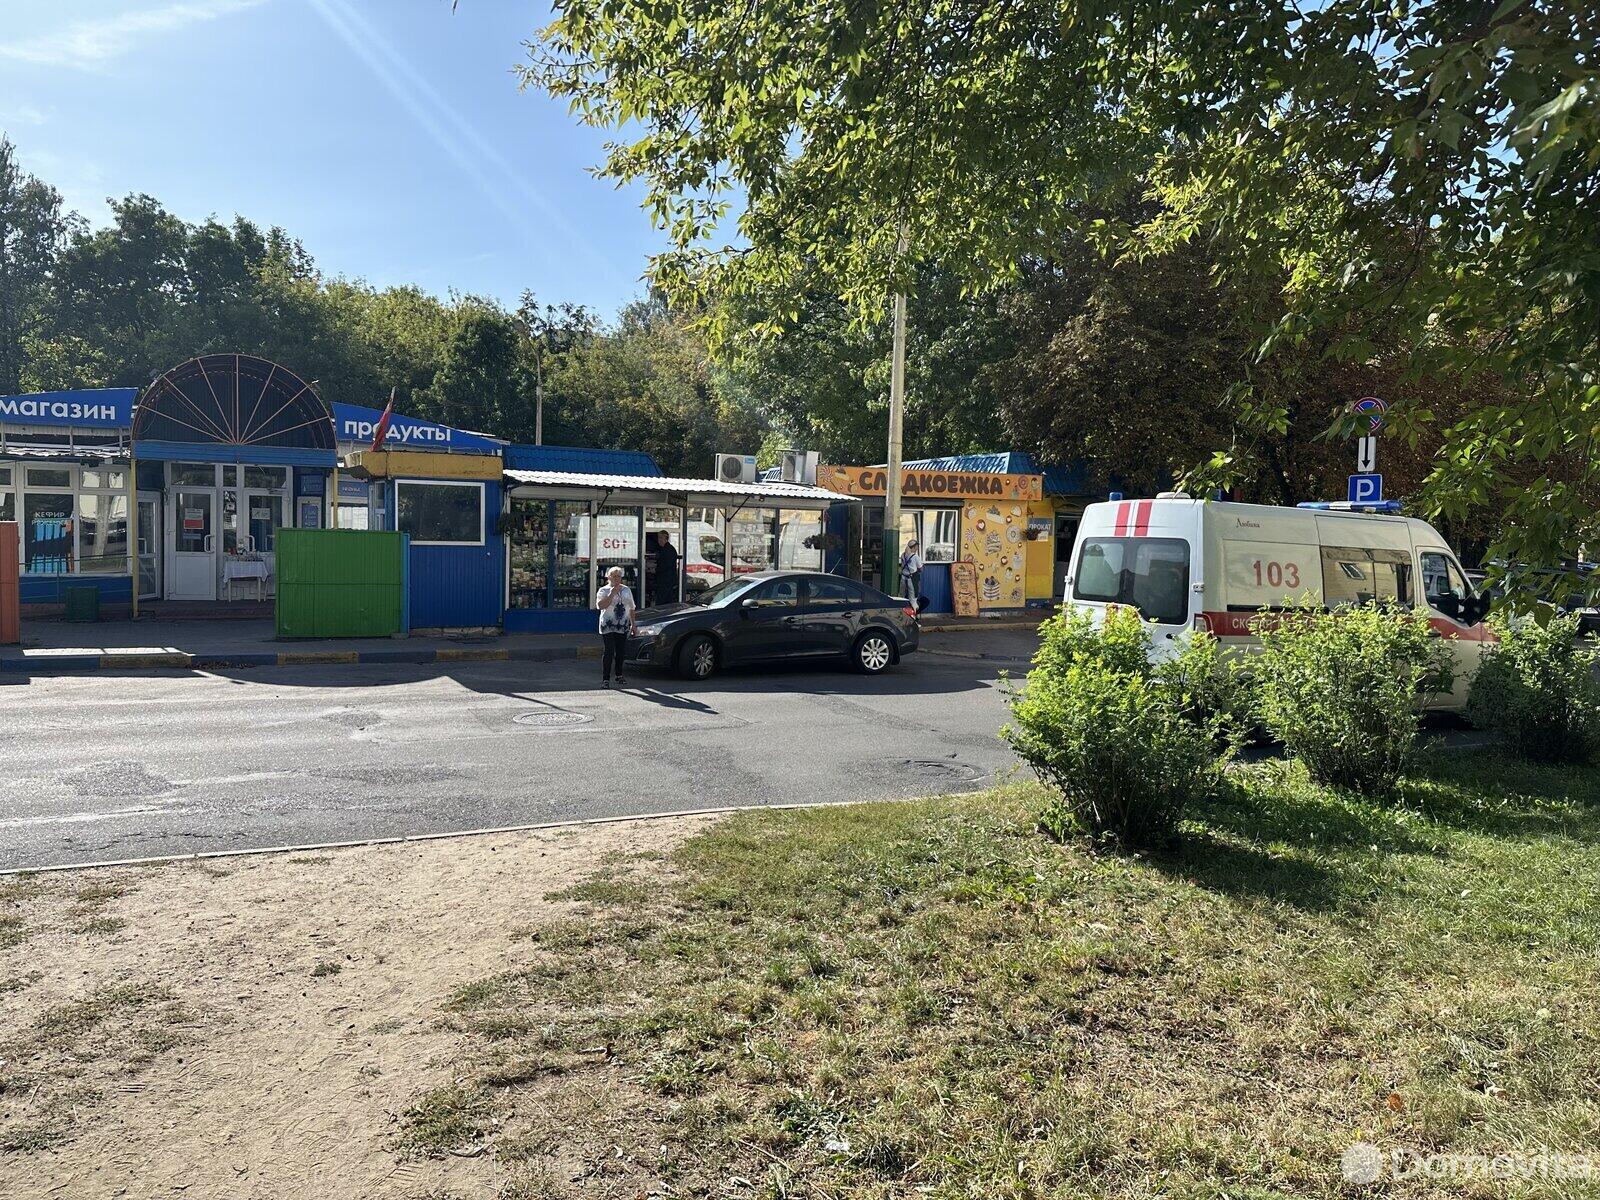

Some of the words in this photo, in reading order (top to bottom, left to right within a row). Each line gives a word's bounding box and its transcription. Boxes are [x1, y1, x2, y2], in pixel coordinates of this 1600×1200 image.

[0, 400, 116, 420] магазин
[858, 471, 1004, 495] СЛДКОЕЖКА
[1356, 478, 1375, 502] P
[1253, 560, 1300, 588] 103
